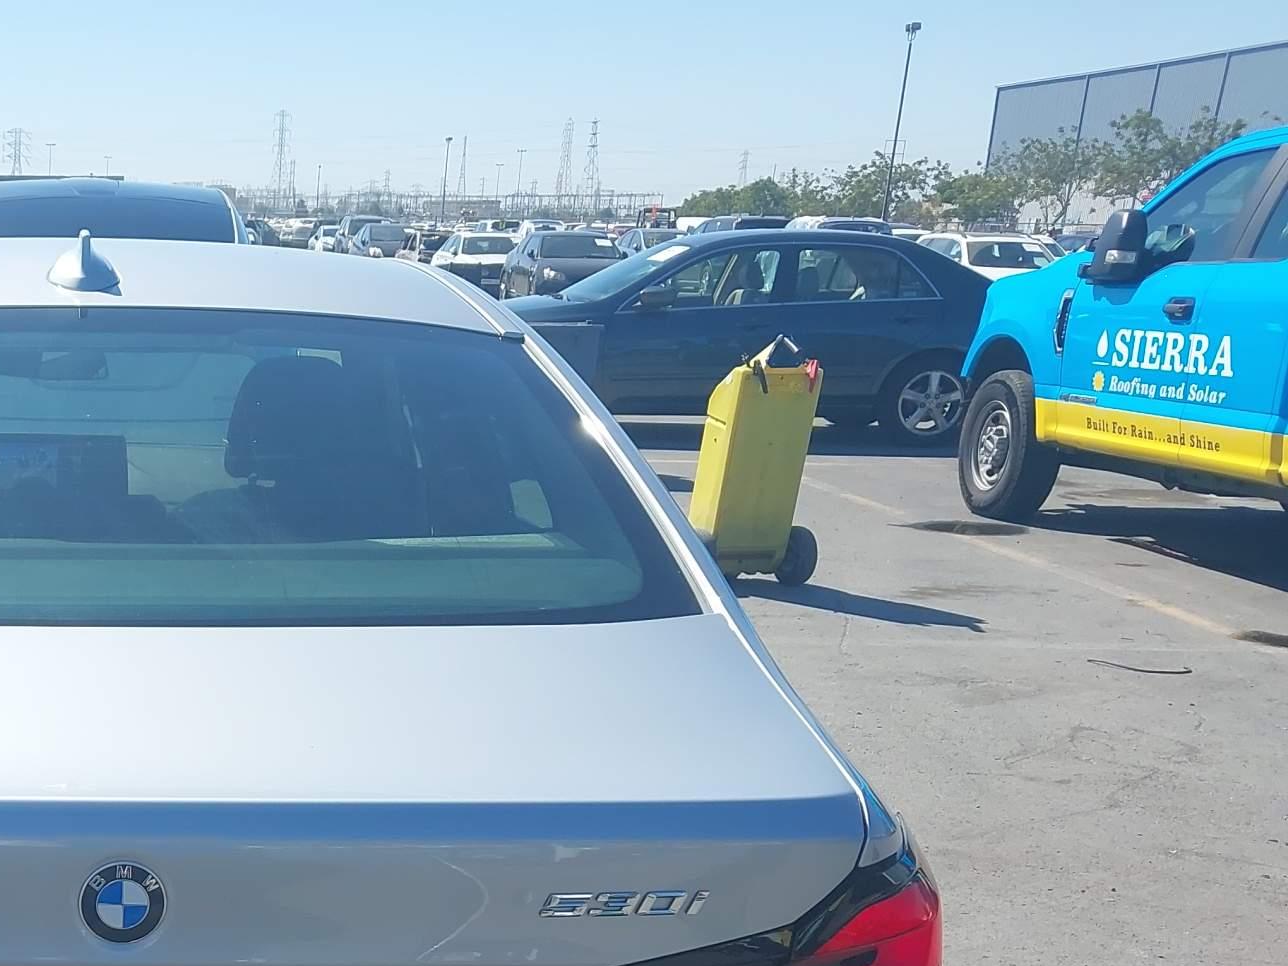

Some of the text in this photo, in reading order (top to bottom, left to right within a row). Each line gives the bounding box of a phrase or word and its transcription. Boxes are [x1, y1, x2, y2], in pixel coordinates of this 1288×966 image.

[1111, 327, 1234, 378] SIERRA
[1108, 375, 1227, 404] Roofing and Solar
[1086, 417, 1110, 433] Built
[1112, 421, 1128, 436] For
[1189, 434, 1221, 452] Shine
[88, 864, 160, 893] BMW
[538, 890, 711, 918] 530i
